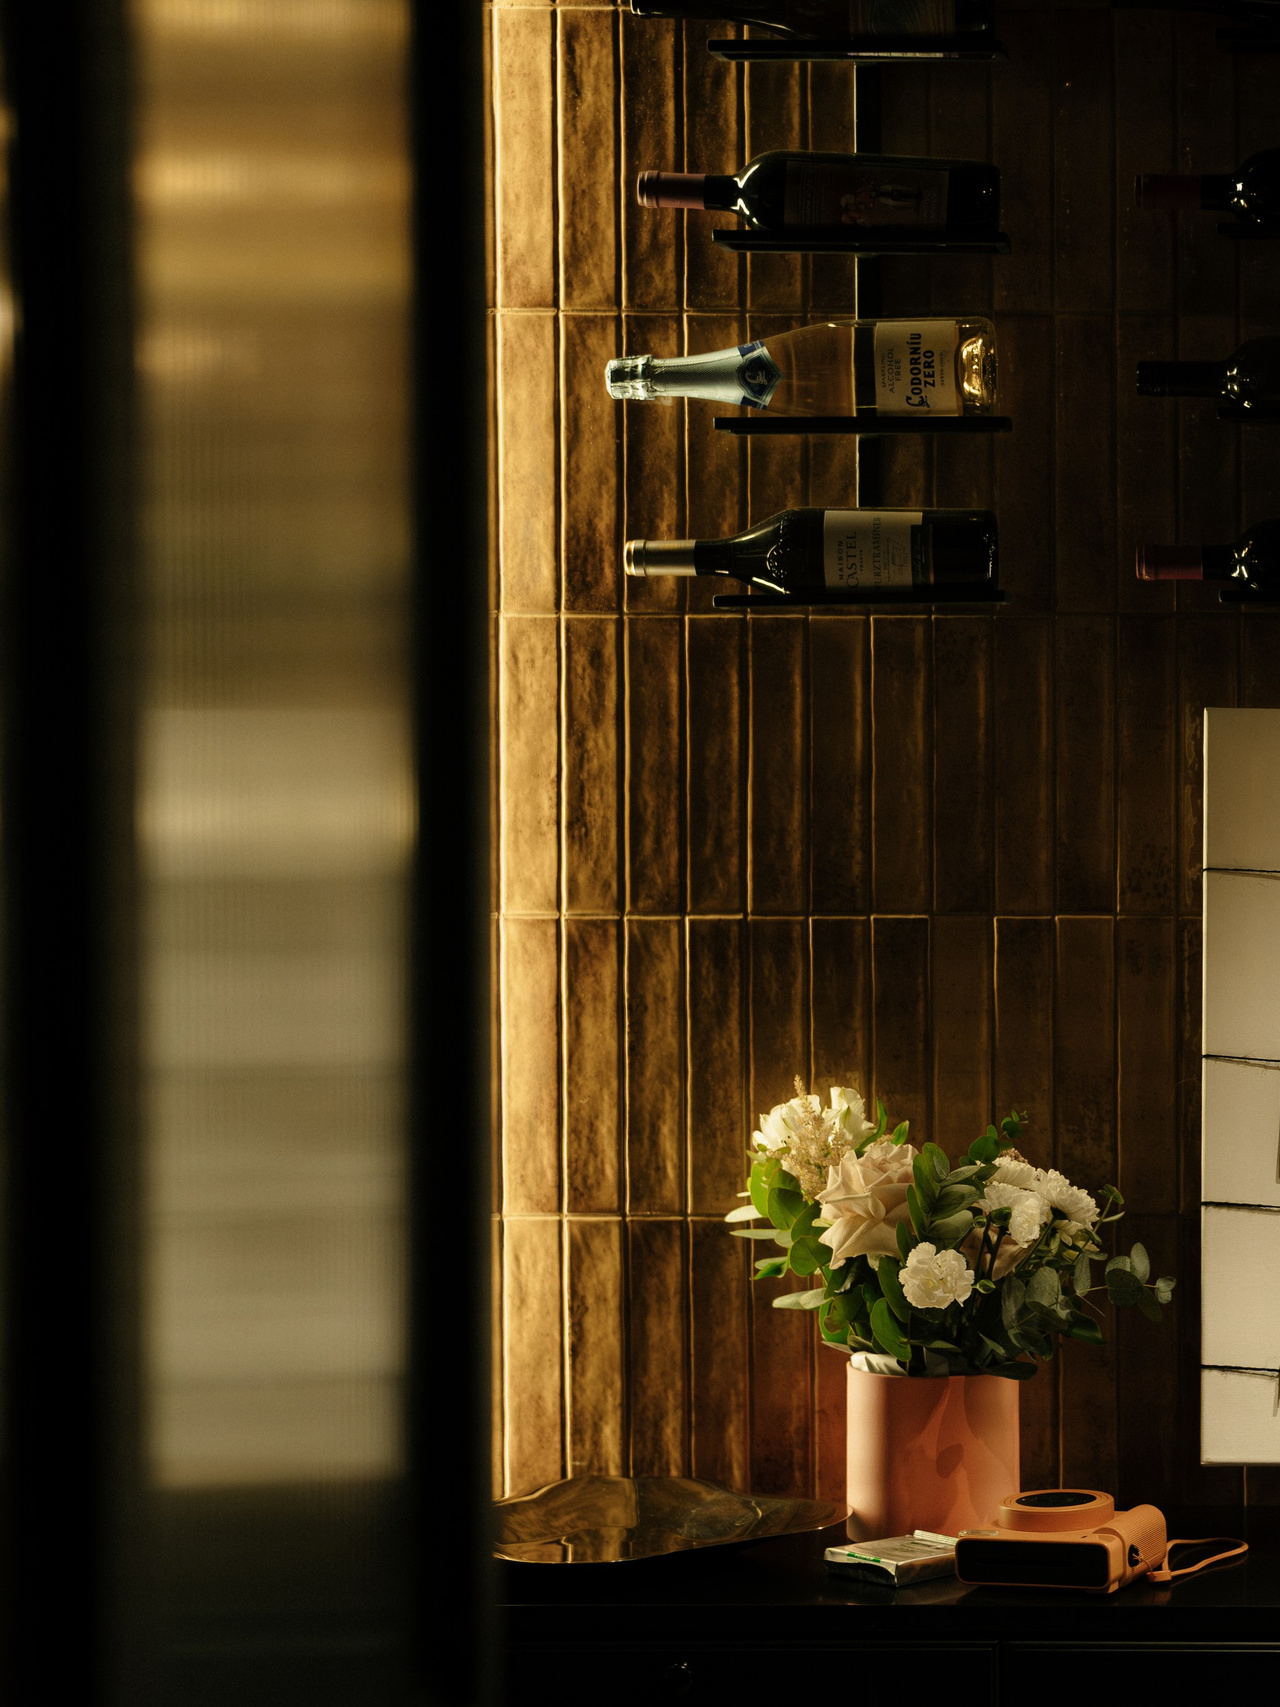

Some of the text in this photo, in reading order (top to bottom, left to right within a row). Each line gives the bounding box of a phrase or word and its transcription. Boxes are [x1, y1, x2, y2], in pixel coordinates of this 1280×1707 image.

[887, 347, 895, 394] ALCOHOL
[894, 358, 902, 382] FREE
[922, 350, 936, 388] ZERO
[846, 531, 859, 589] CASTEL
